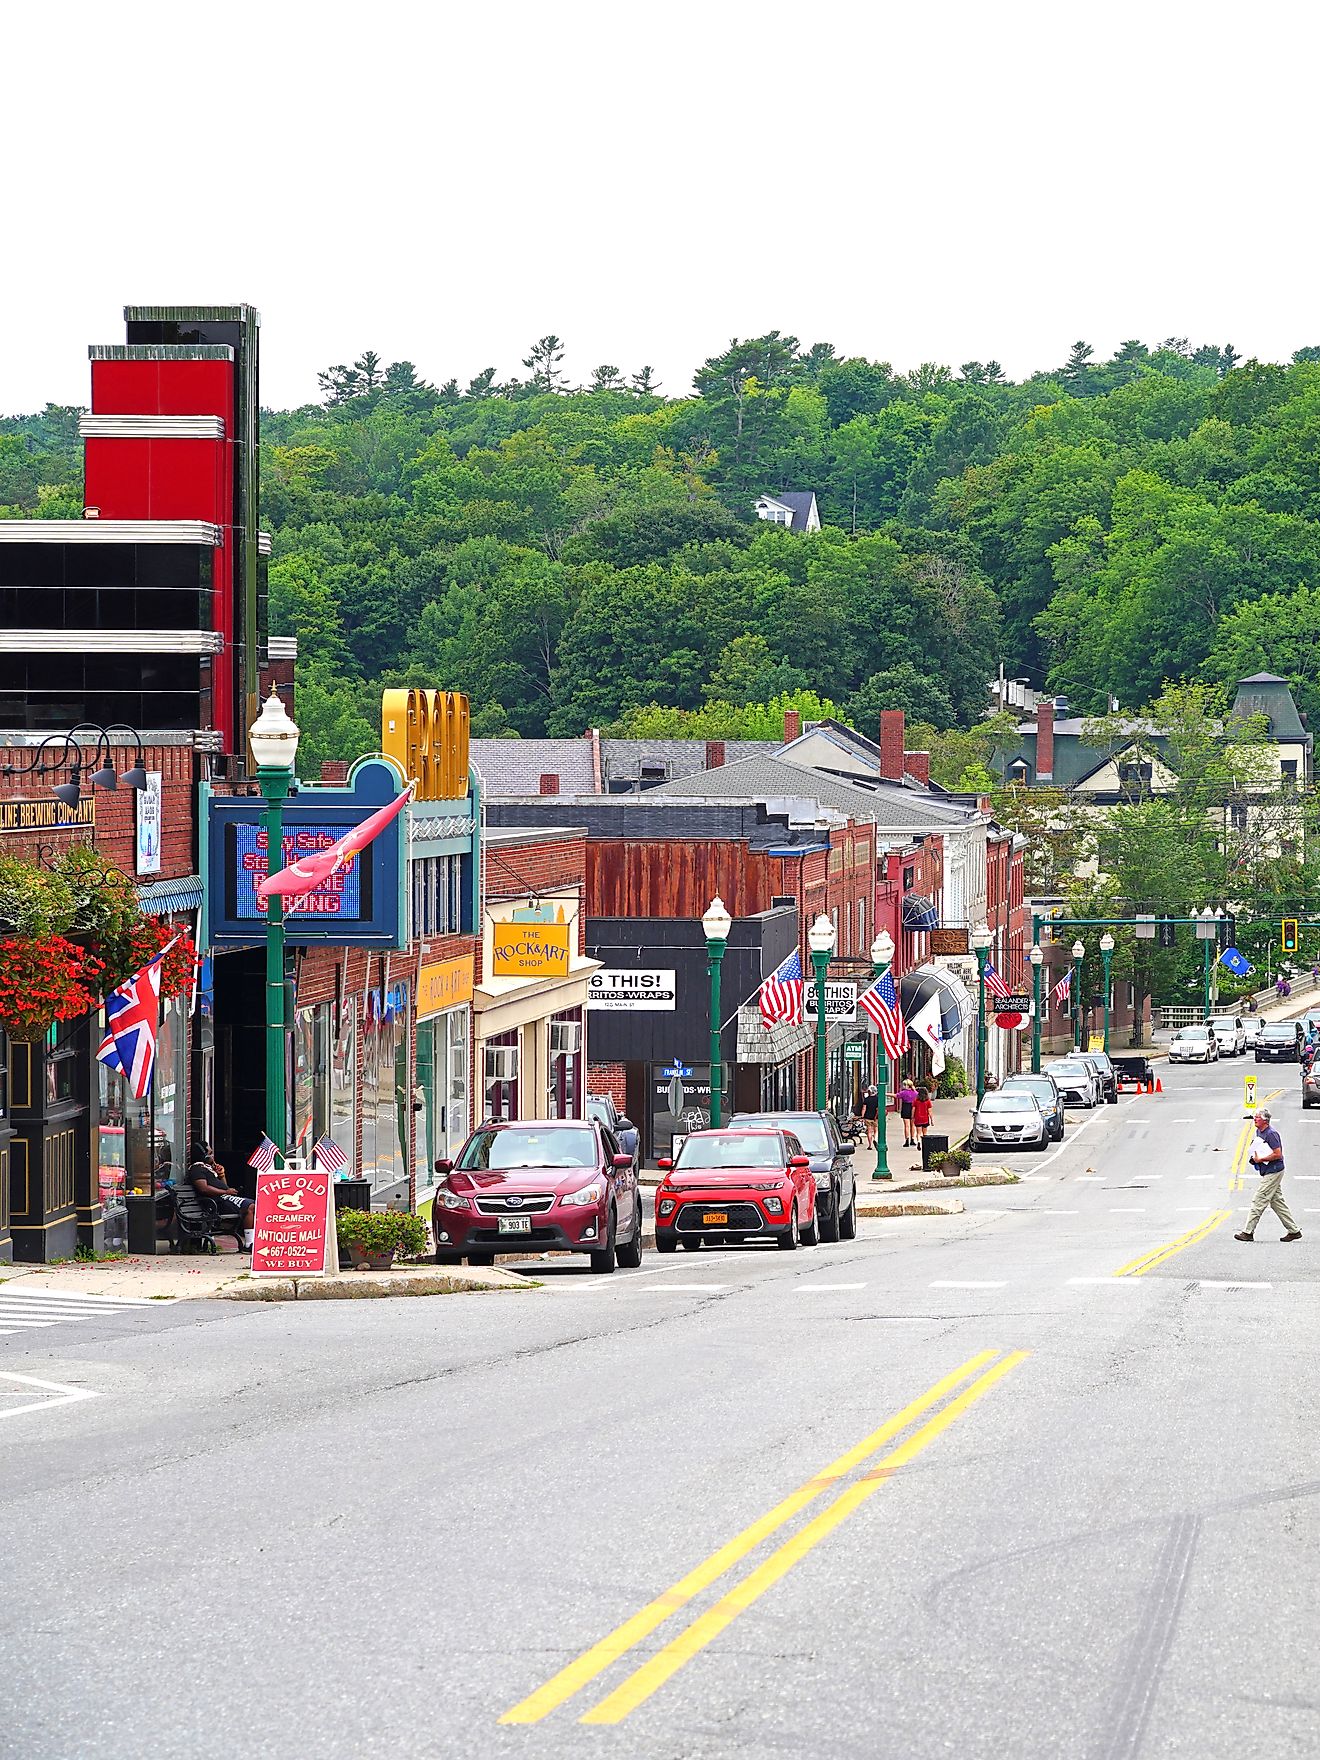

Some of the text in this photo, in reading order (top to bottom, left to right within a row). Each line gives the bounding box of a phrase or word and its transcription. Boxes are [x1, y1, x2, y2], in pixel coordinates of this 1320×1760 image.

[20, 801, 56, 827] BREWING
[57, 799, 94, 825] COMPANY
[257, 893, 341, 913] SRONG
[523, 931, 540, 939] THE
[519, 959, 543, 967] SHOP
[588, 975, 661, 988] 6 THIS!
[824, 986, 854, 999] THIS!
[260, 1177, 326, 1196] THE OLD
[265, 1214, 316, 1223] CREAMERY
[508, 1221, 520, 1230] 903
[257, 1228, 323, 1243] ANTIQUE MALL
[270, 1245, 307, 1257] 667-0522
